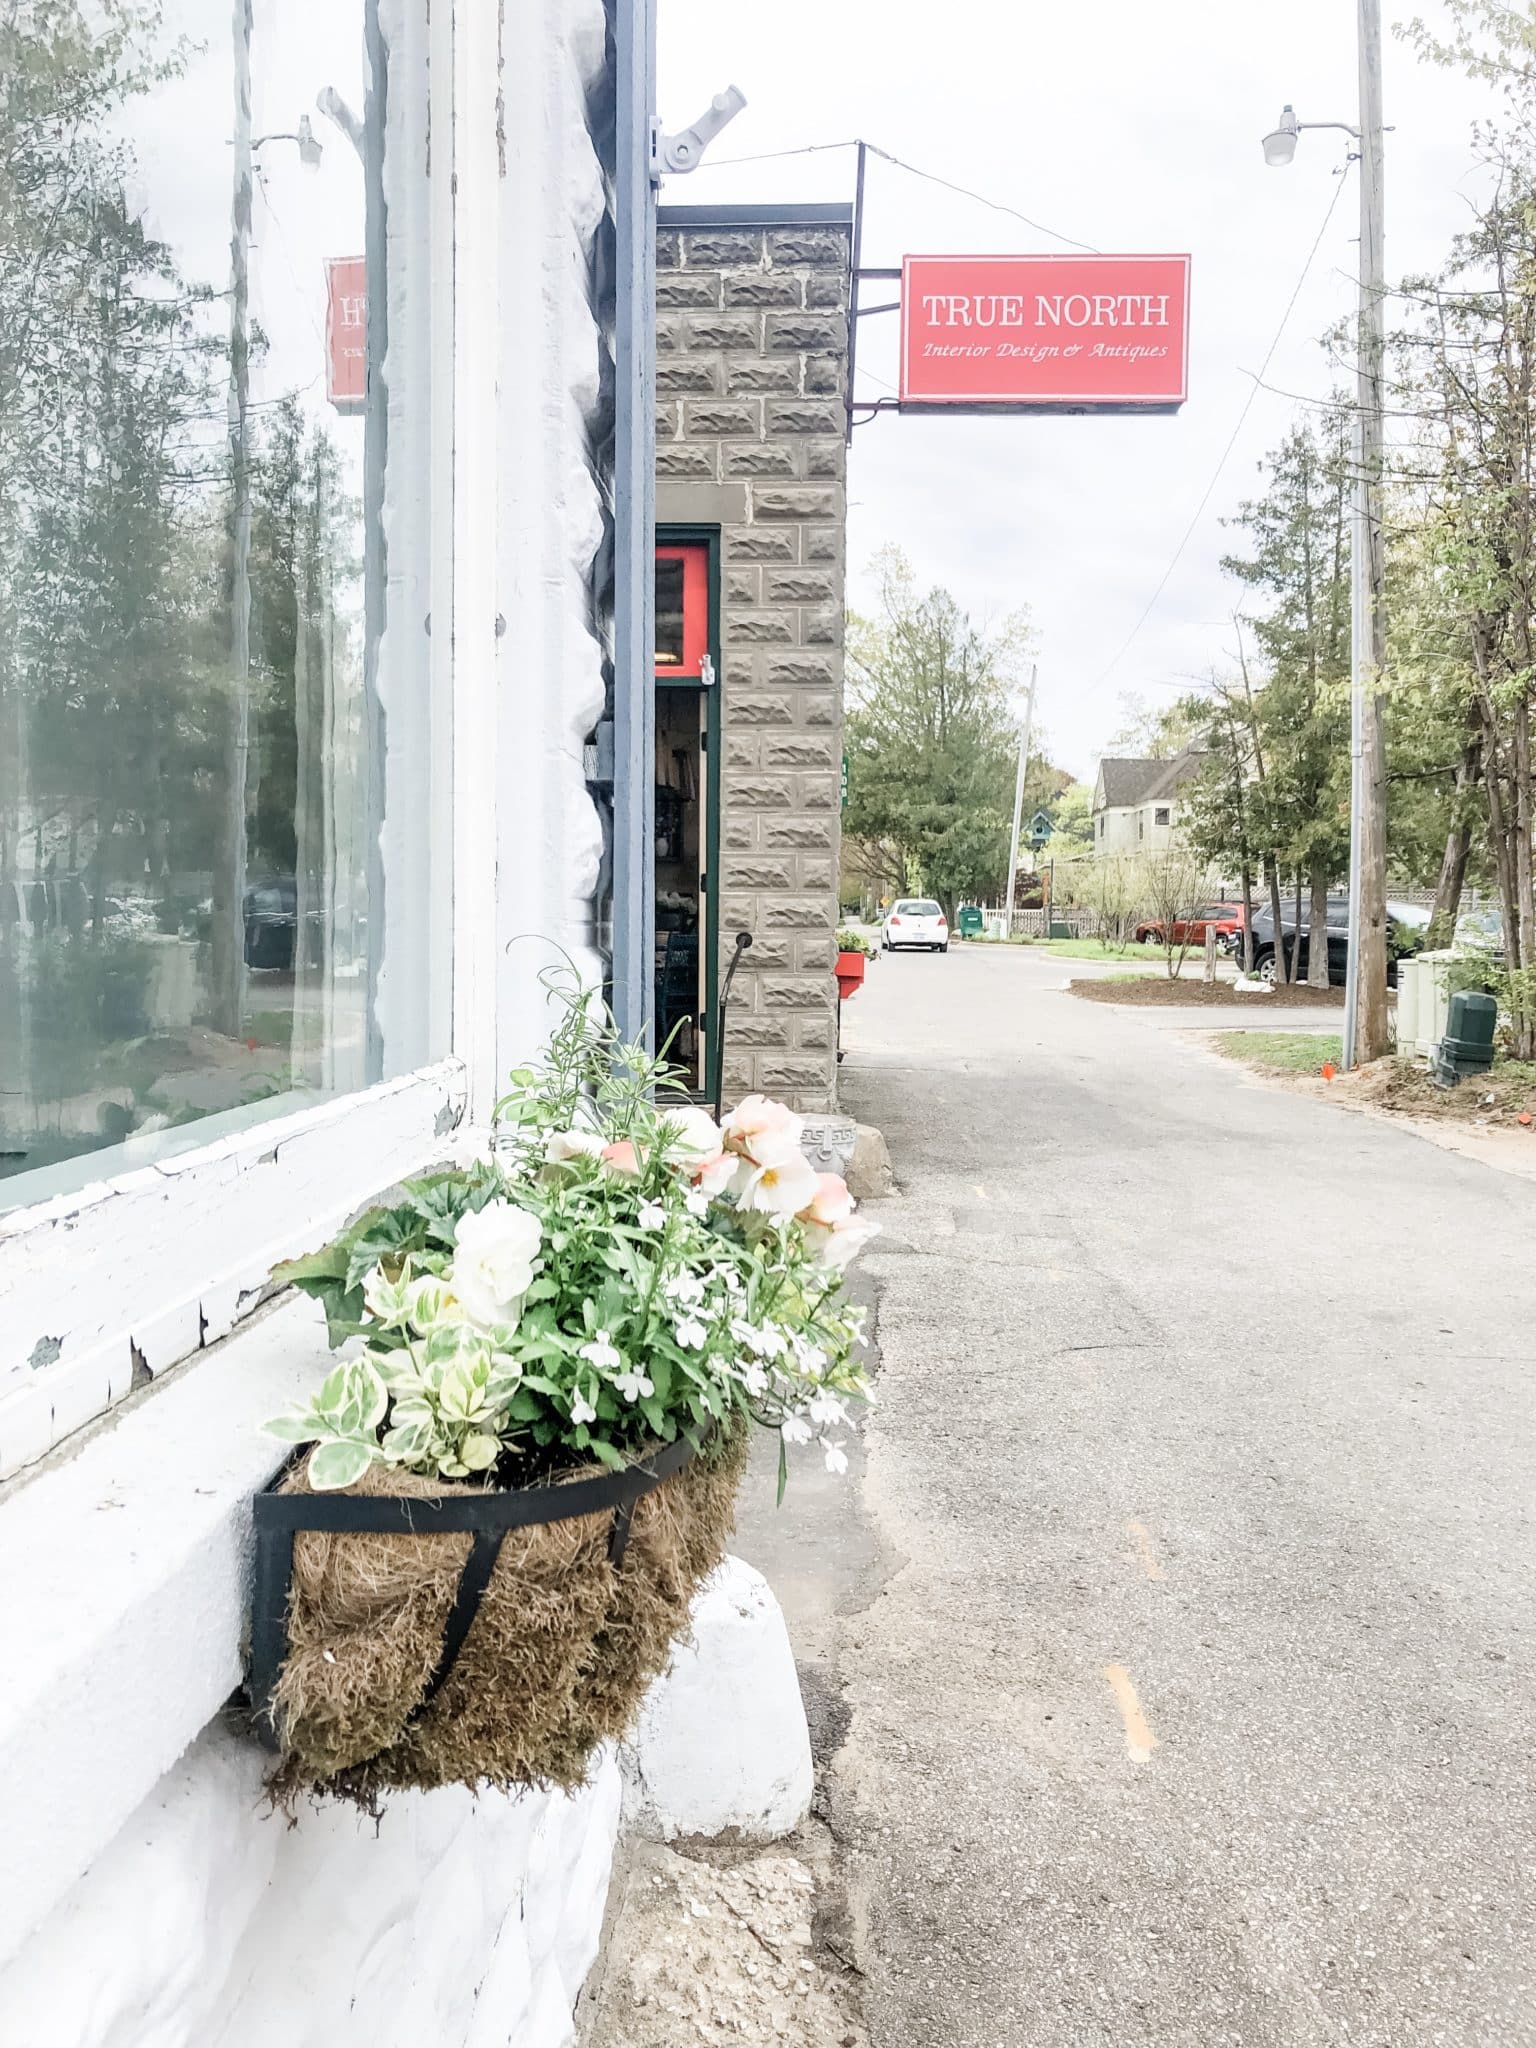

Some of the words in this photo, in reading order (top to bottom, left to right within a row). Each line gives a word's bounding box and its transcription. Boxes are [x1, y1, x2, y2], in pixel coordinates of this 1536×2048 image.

[922, 295, 1024, 327] TRUE
[1034, 294, 1170, 327] NORTH
[921, 343, 992, 358] Interior
[995, 343, 1059, 363] Design
[1062, 344, 1084, 358] &
[1087, 343, 1169, 363] Antiques
